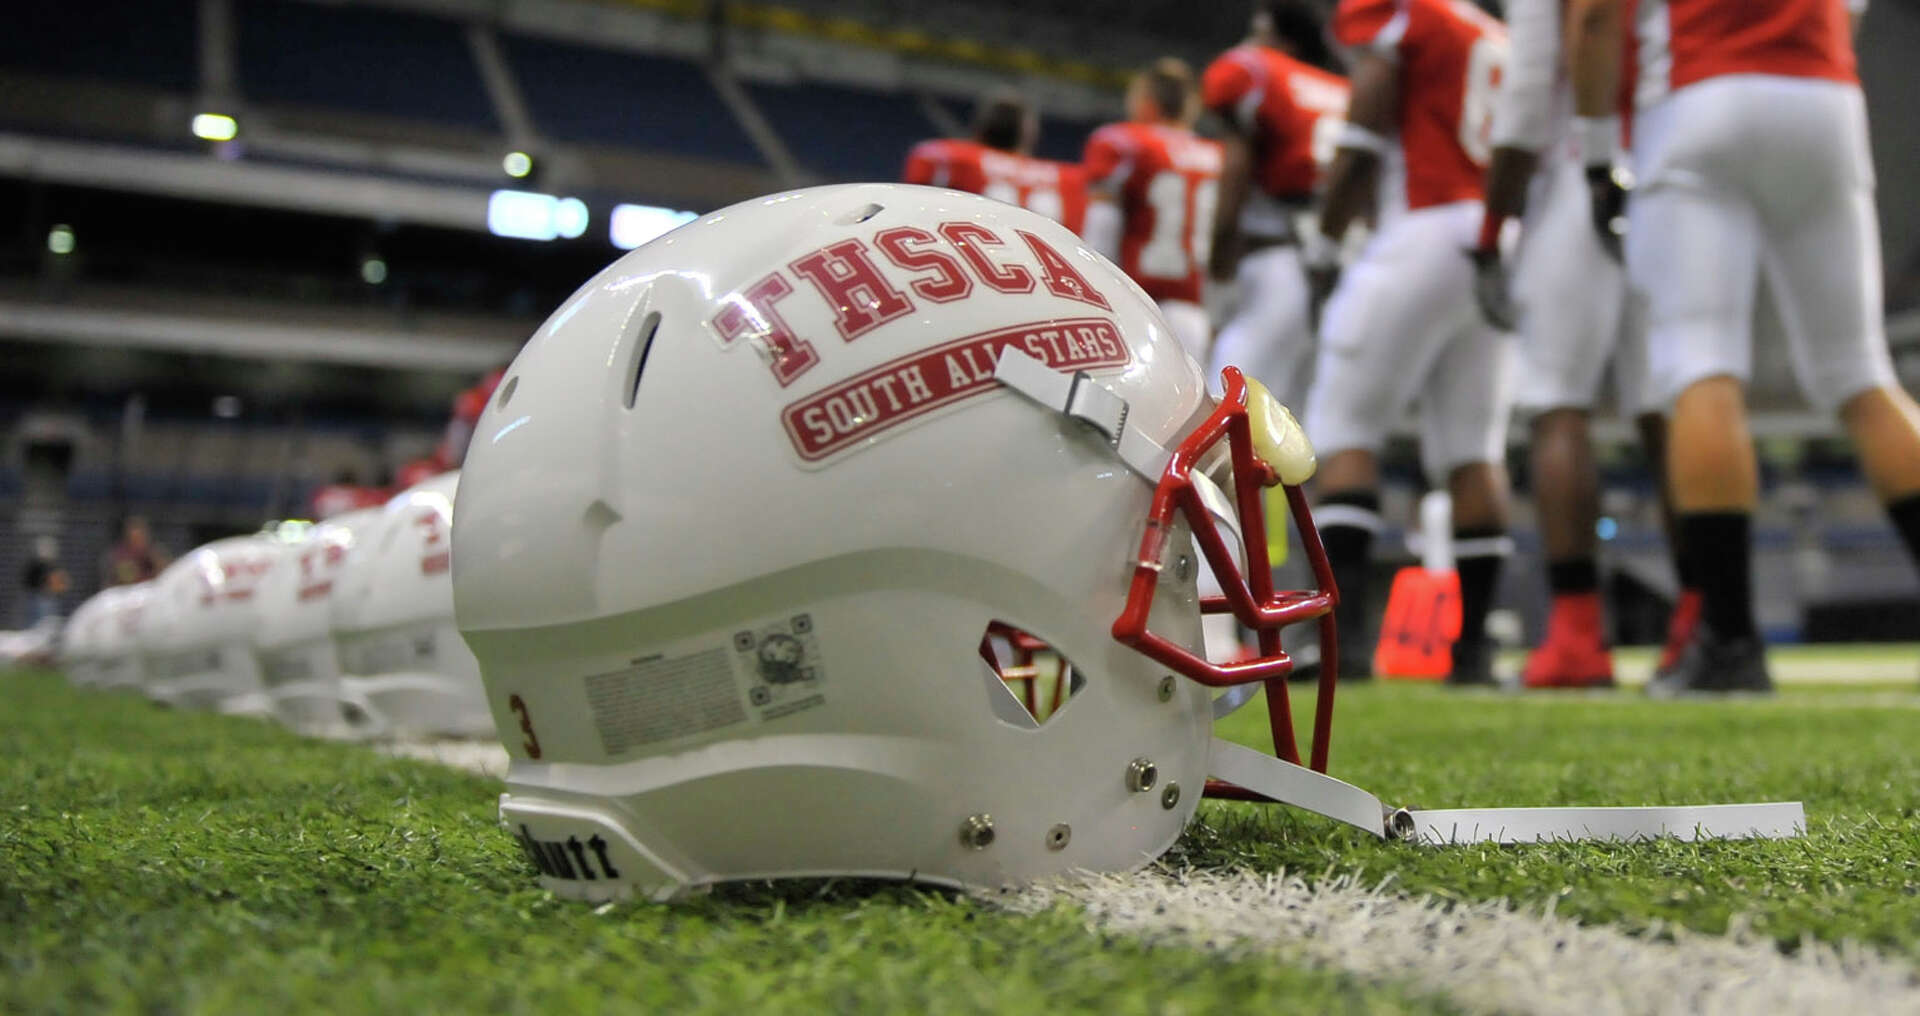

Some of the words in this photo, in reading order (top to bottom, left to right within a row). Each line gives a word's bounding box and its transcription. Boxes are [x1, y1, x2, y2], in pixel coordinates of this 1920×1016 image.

[711, 221, 1113, 388] THSCA
[803, 365, 933, 444] SOUTH
[1023, 326, 1119, 367] STARS
[509, 694, 541, 760] 3
[512, 823, 620, 880] hutt
